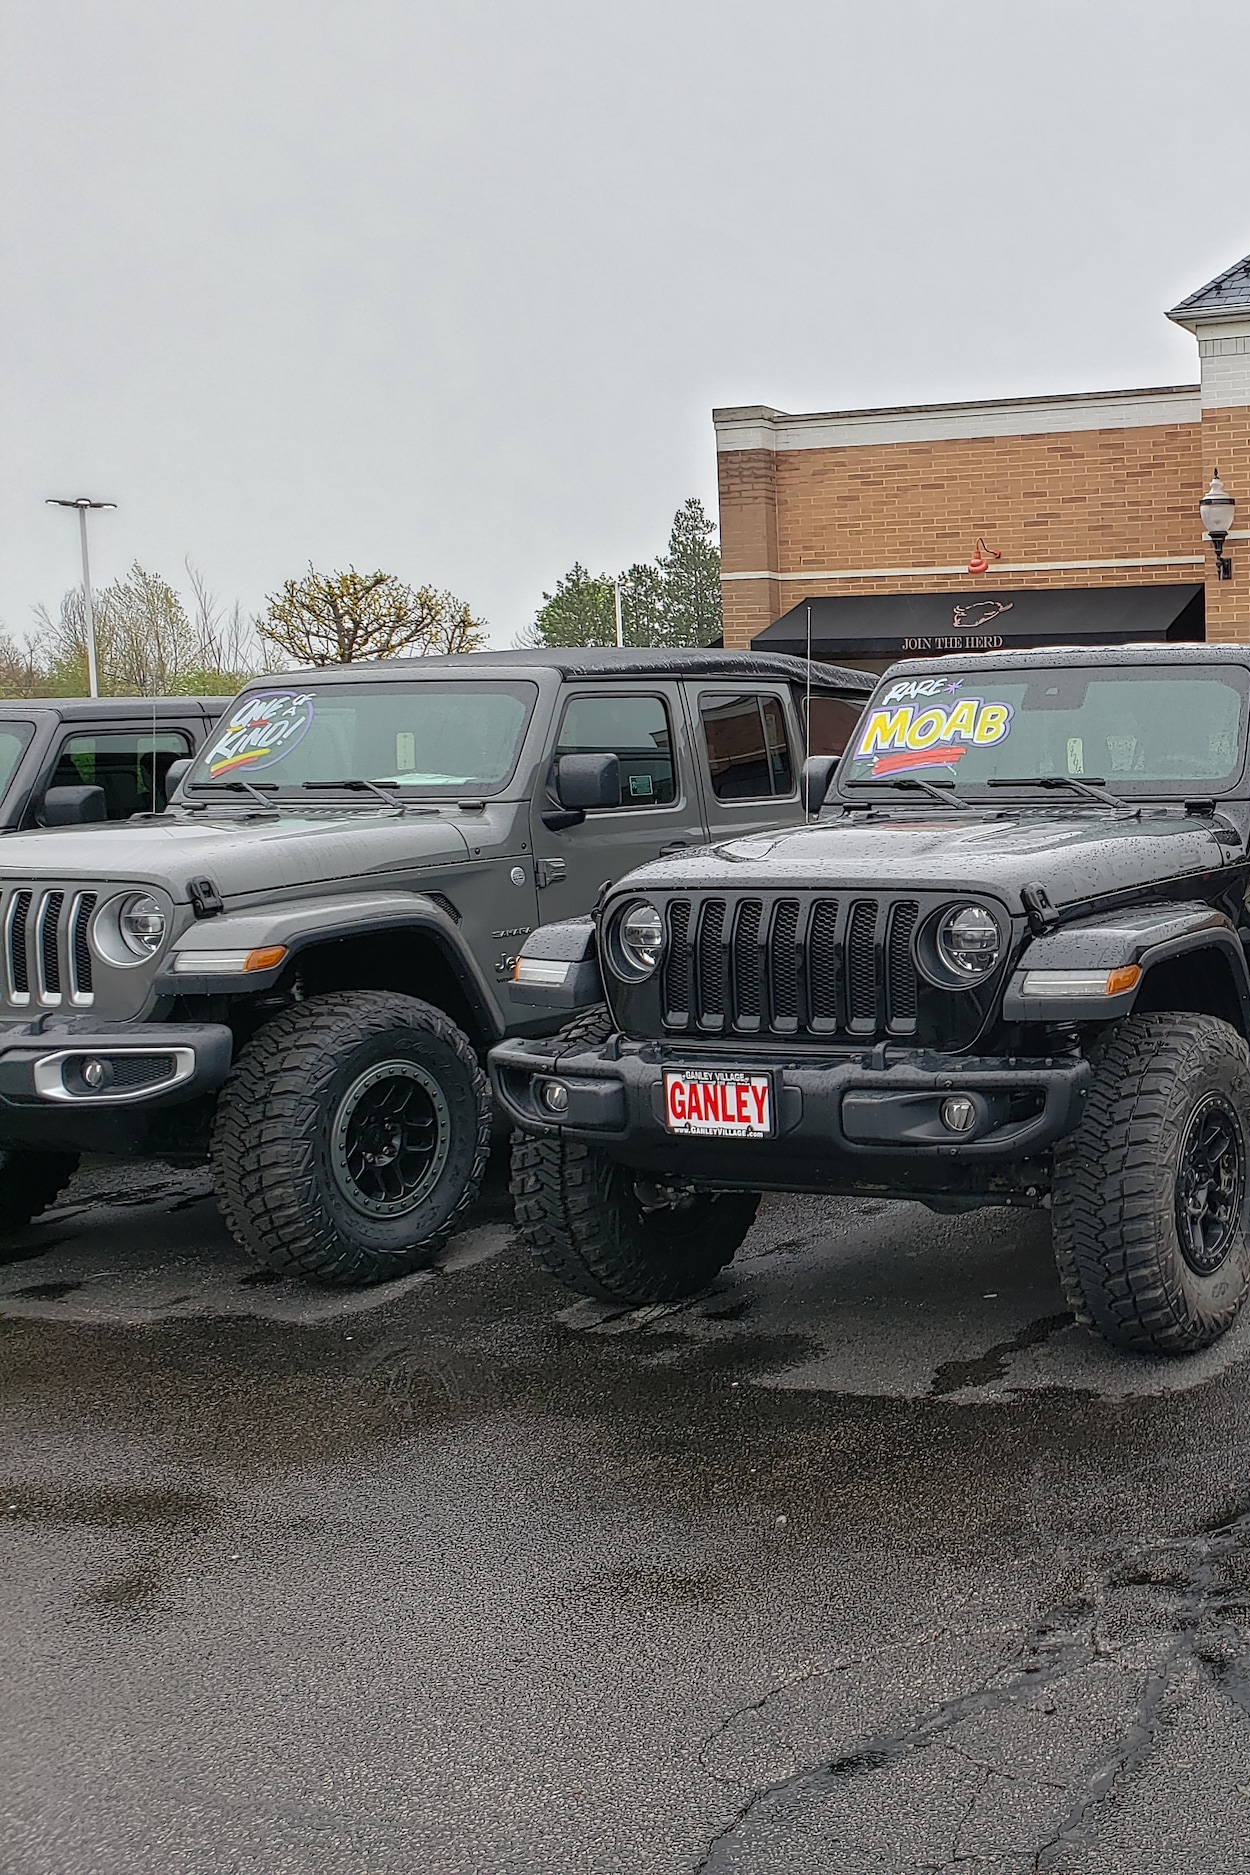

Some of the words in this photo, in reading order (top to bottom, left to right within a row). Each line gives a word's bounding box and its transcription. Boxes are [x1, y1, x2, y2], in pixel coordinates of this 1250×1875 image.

[902, 638, 932, 650] JOIN
[935, 637, 962, 649] THE
[965, 635, 1003, 648] HERD
[882, 679, 949, 706] RARE
[230, 696, 291, 727] ONE
[292, 693, 317, 706] OF
[281, 706, 297, 717] A
[205, 716, 306, 765] KIND!
[855, 699, 1012, 758] MOAB
[686, 1071, 713, 1081] GANLEY
[715, 1072, 745, 1082] VILLAGE
[670, 1081, 768, 1124] GANLEY
